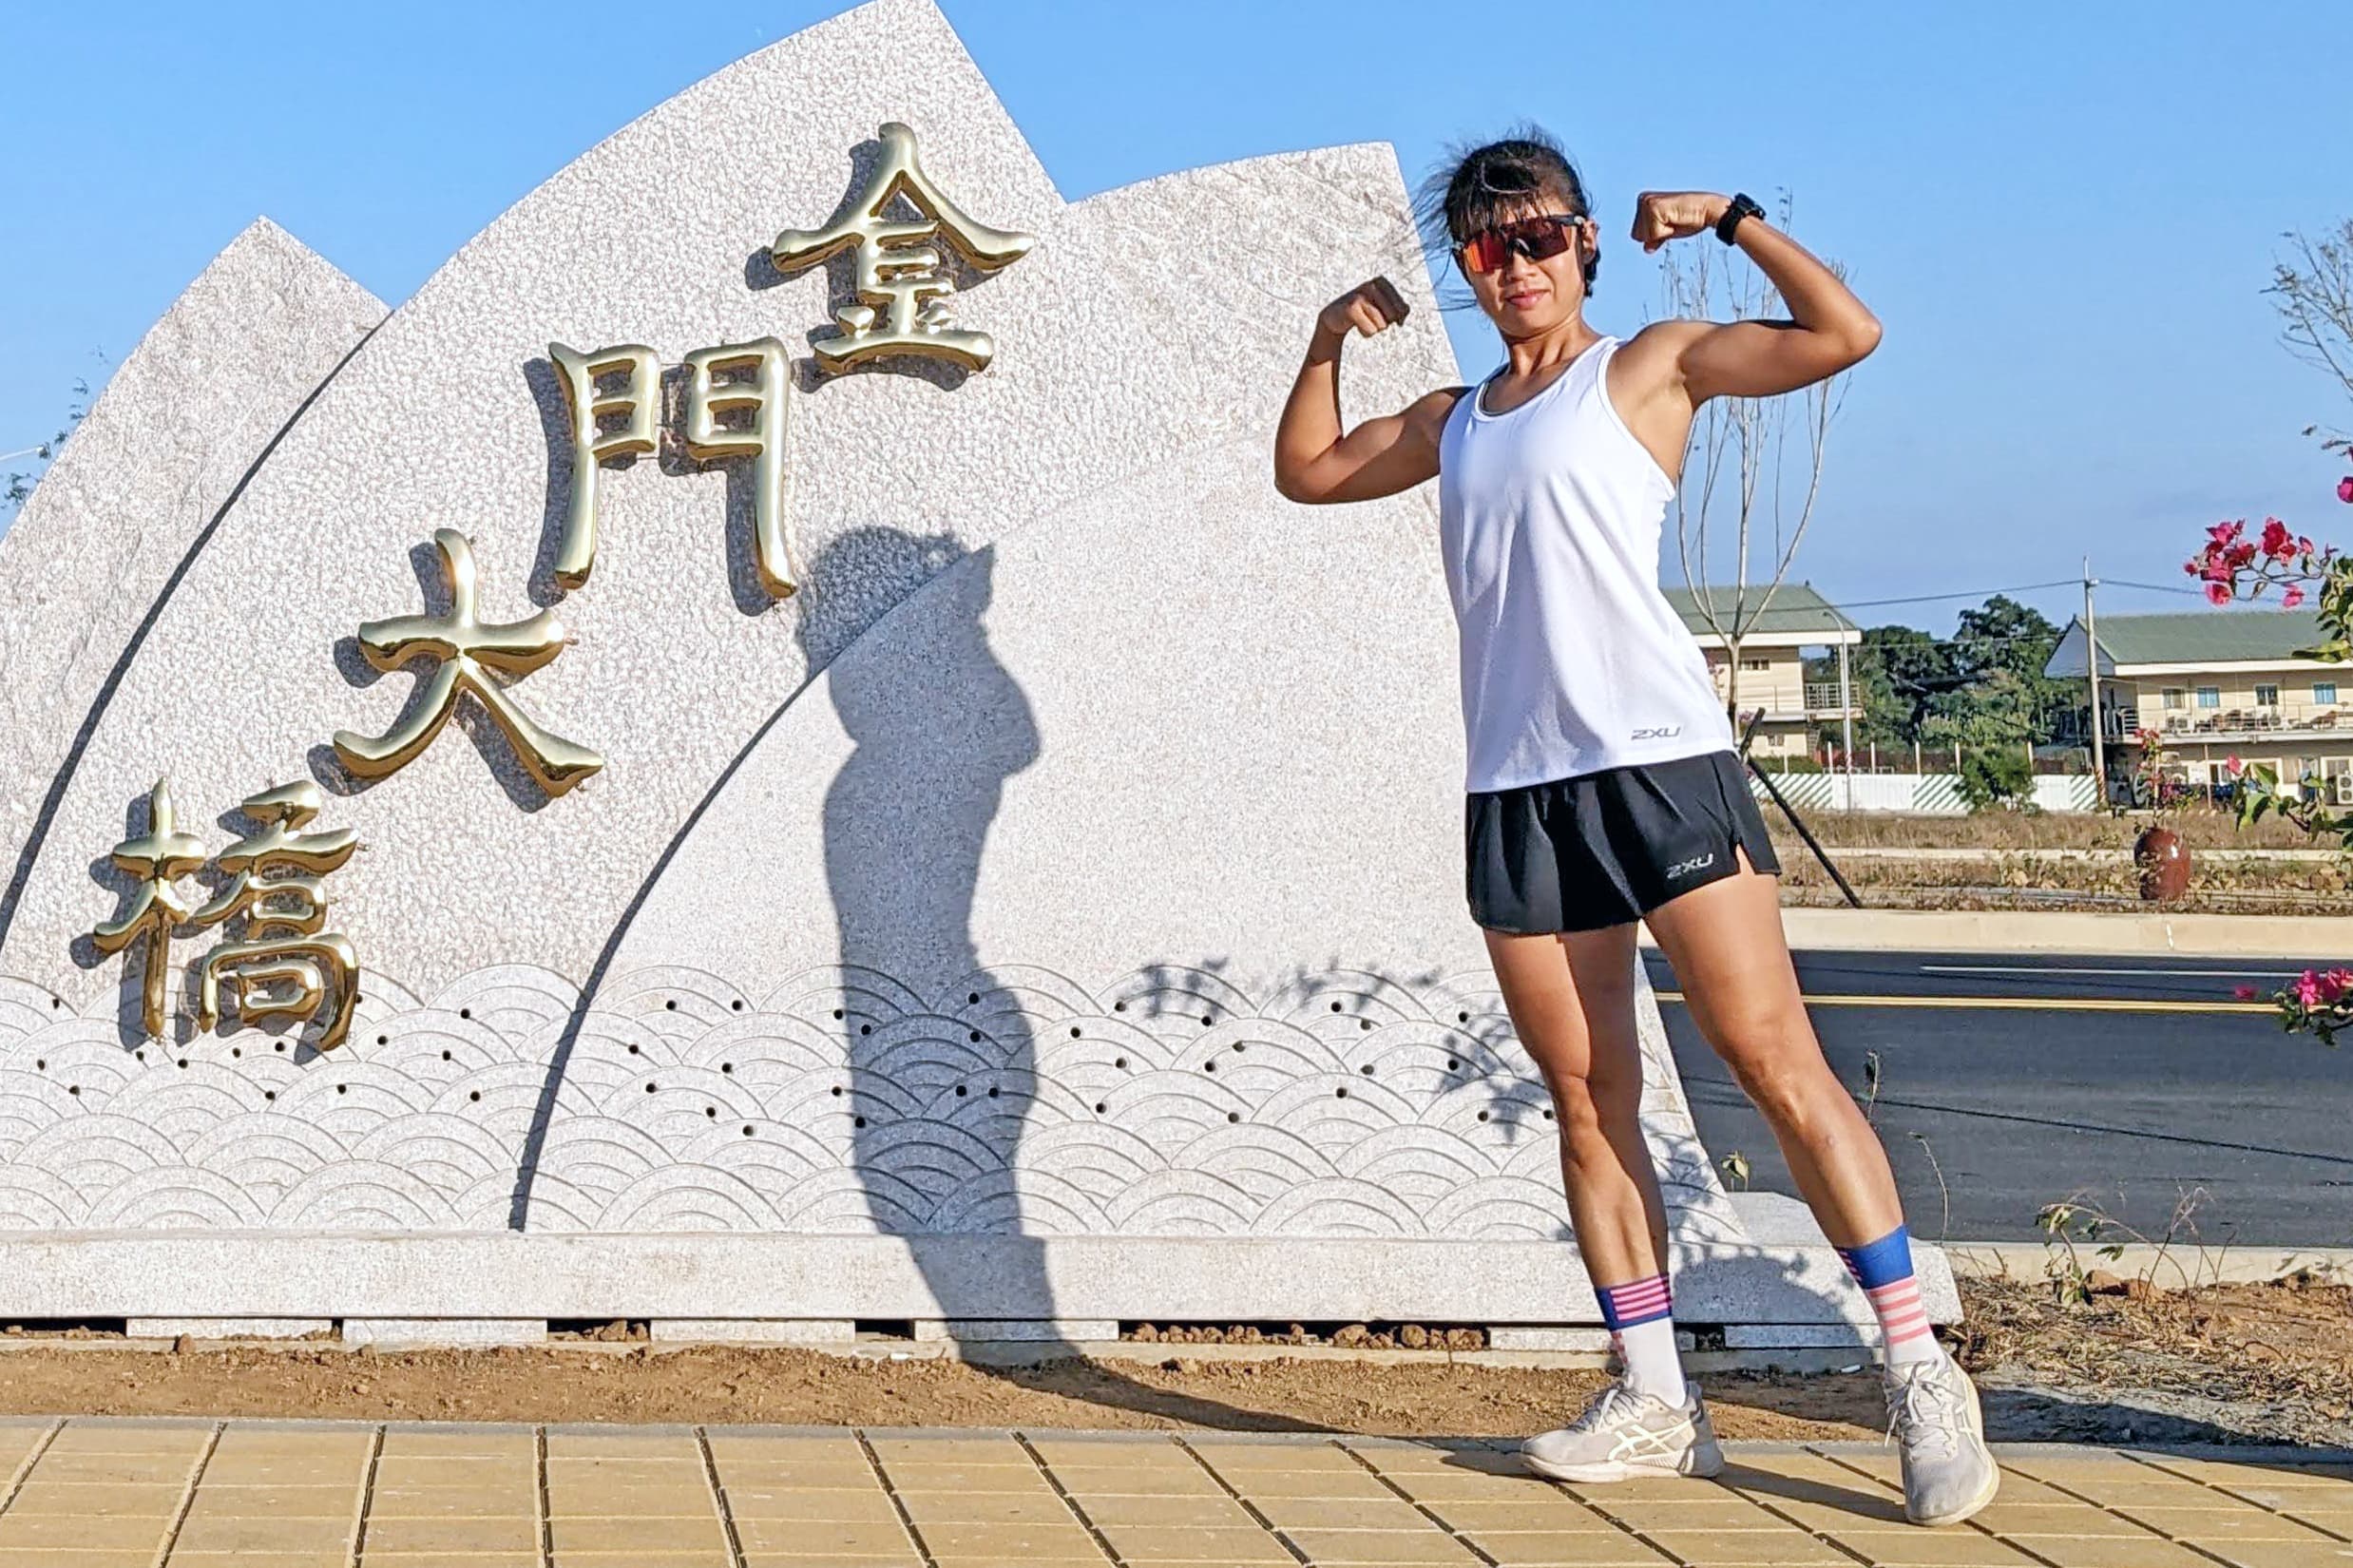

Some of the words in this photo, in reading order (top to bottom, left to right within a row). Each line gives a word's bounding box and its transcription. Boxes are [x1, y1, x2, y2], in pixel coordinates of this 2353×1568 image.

[92, 122, 1034, 1052] 金門大橋
[1666, 852, 1714, 880] 2XU
